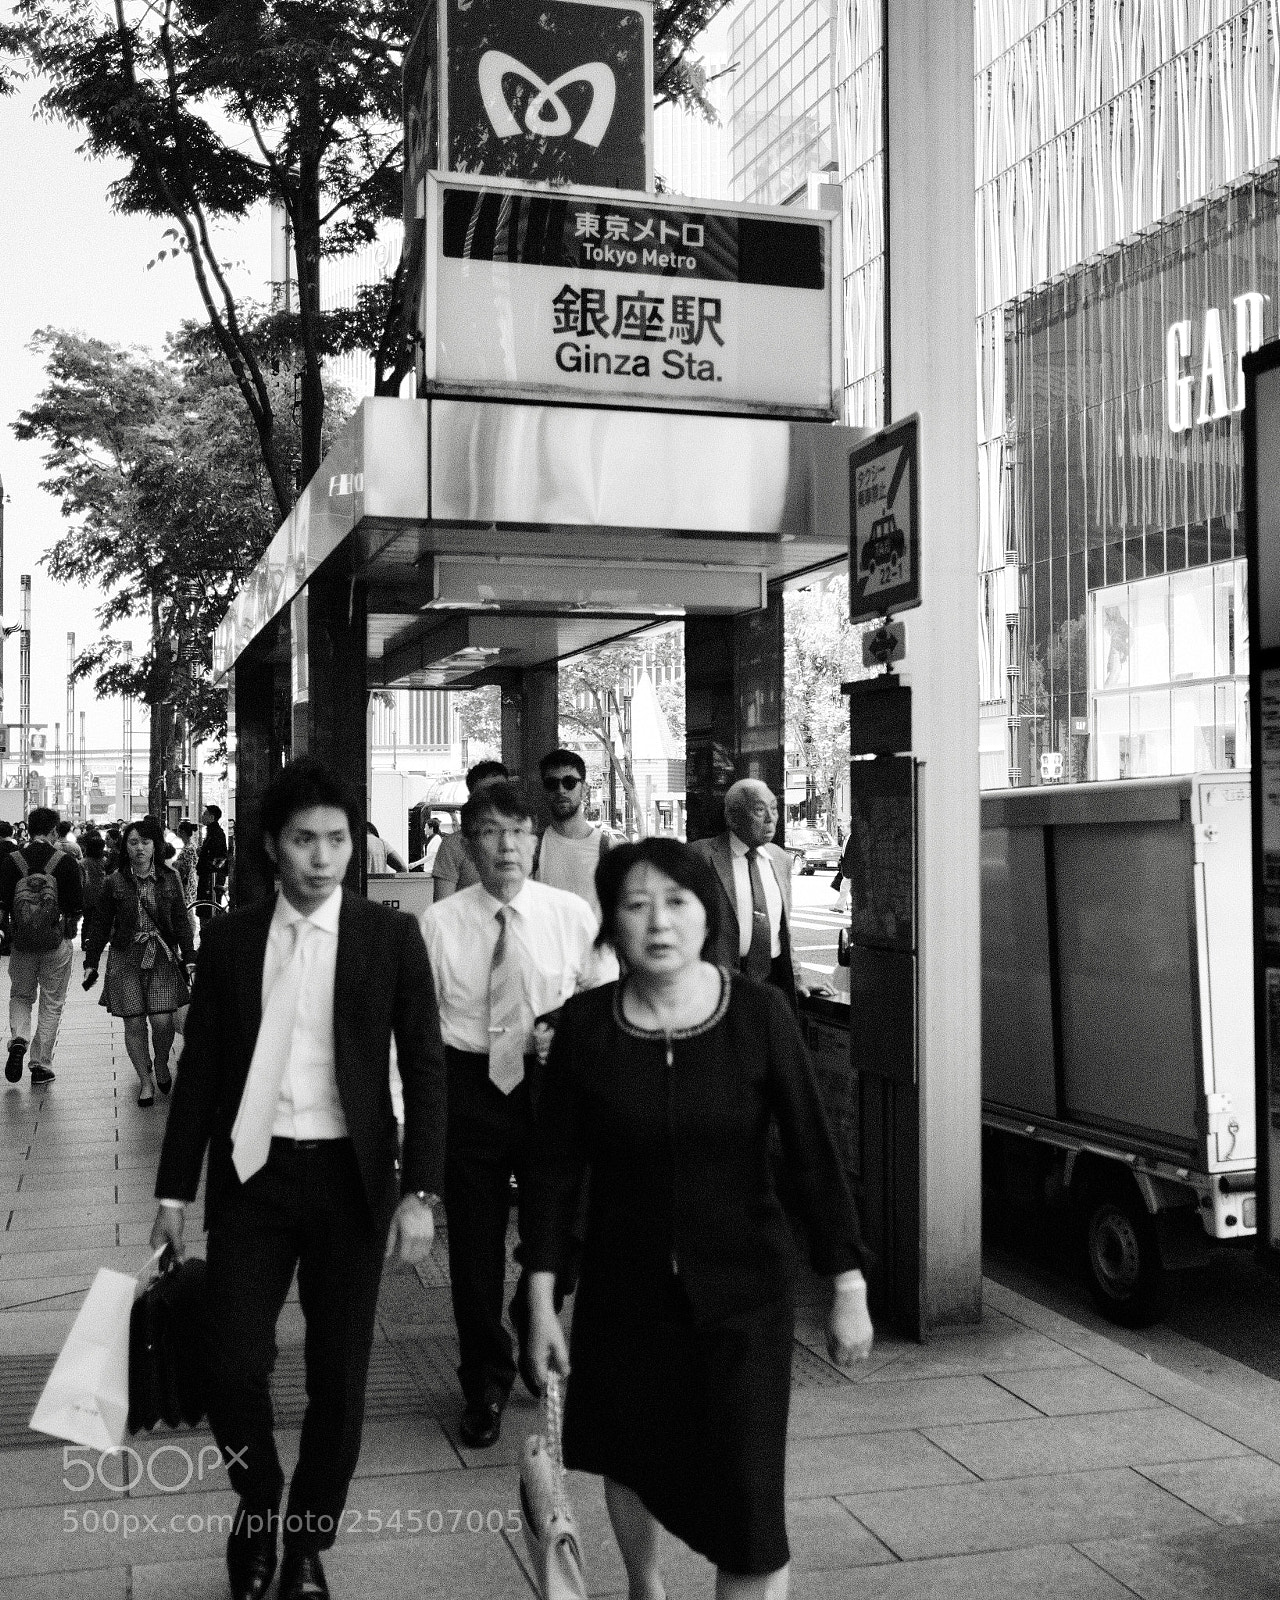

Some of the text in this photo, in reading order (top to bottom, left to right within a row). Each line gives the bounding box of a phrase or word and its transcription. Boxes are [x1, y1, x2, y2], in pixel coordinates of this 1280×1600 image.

[575, 212, 704, 247] 東京メトロ
[583, 243, 697, 270] Tokyo Metro
[552, 284, 725, 347] 銀座駅
[555, 342, 723, 382] Ginza Sta.
[1167, 292, 1264, 432] GAP
